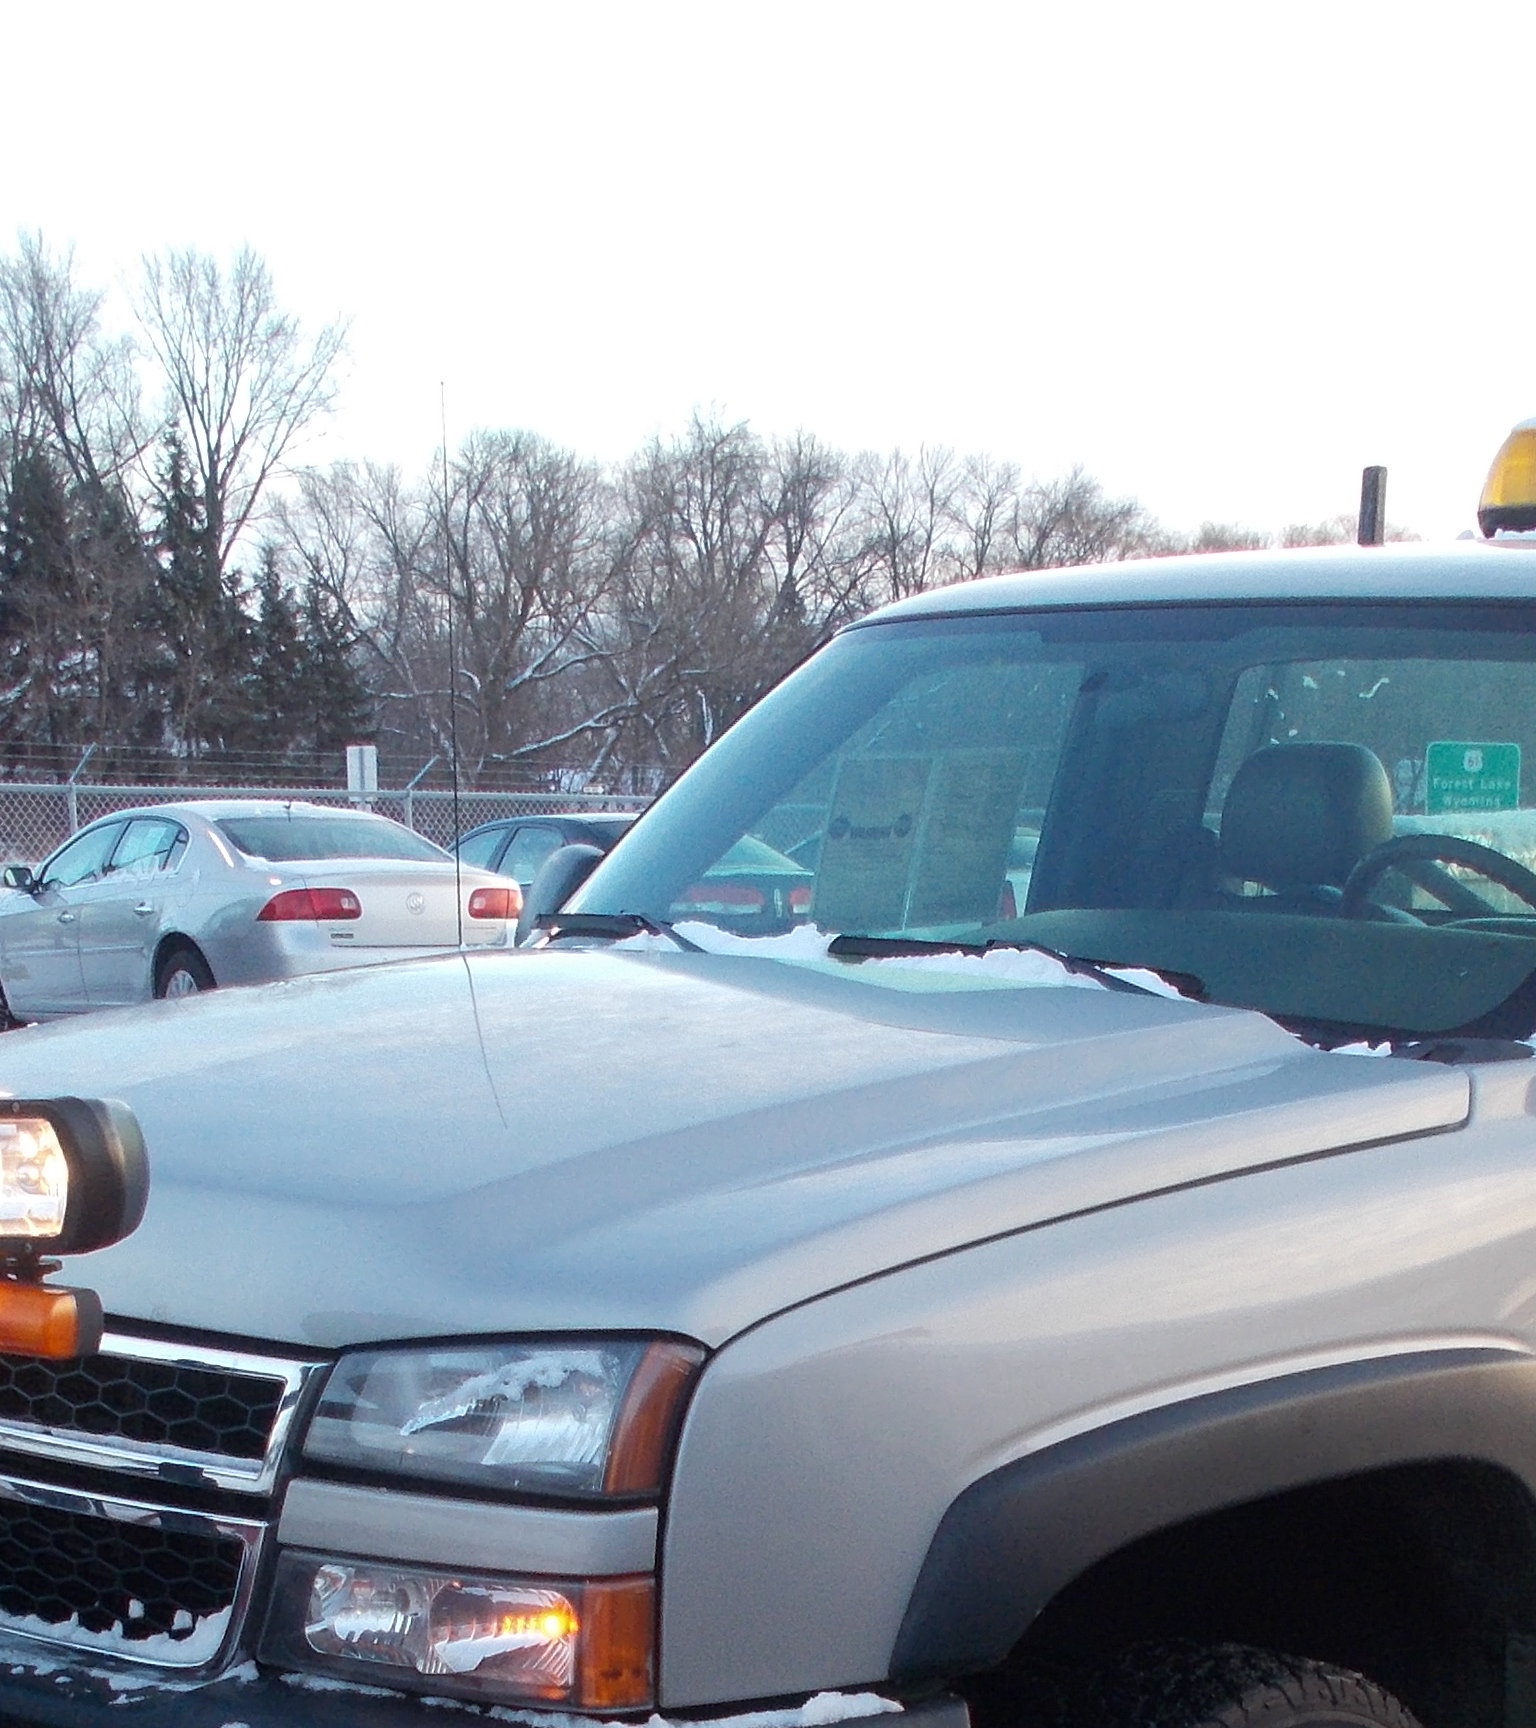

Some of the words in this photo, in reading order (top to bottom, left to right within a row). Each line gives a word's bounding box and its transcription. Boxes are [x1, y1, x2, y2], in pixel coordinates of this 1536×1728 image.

[1432, 777, 1474, 790] Forest
[1480, 779, 1512, 790] Lake
[1443, 795, 1502, 809] Wyoming
